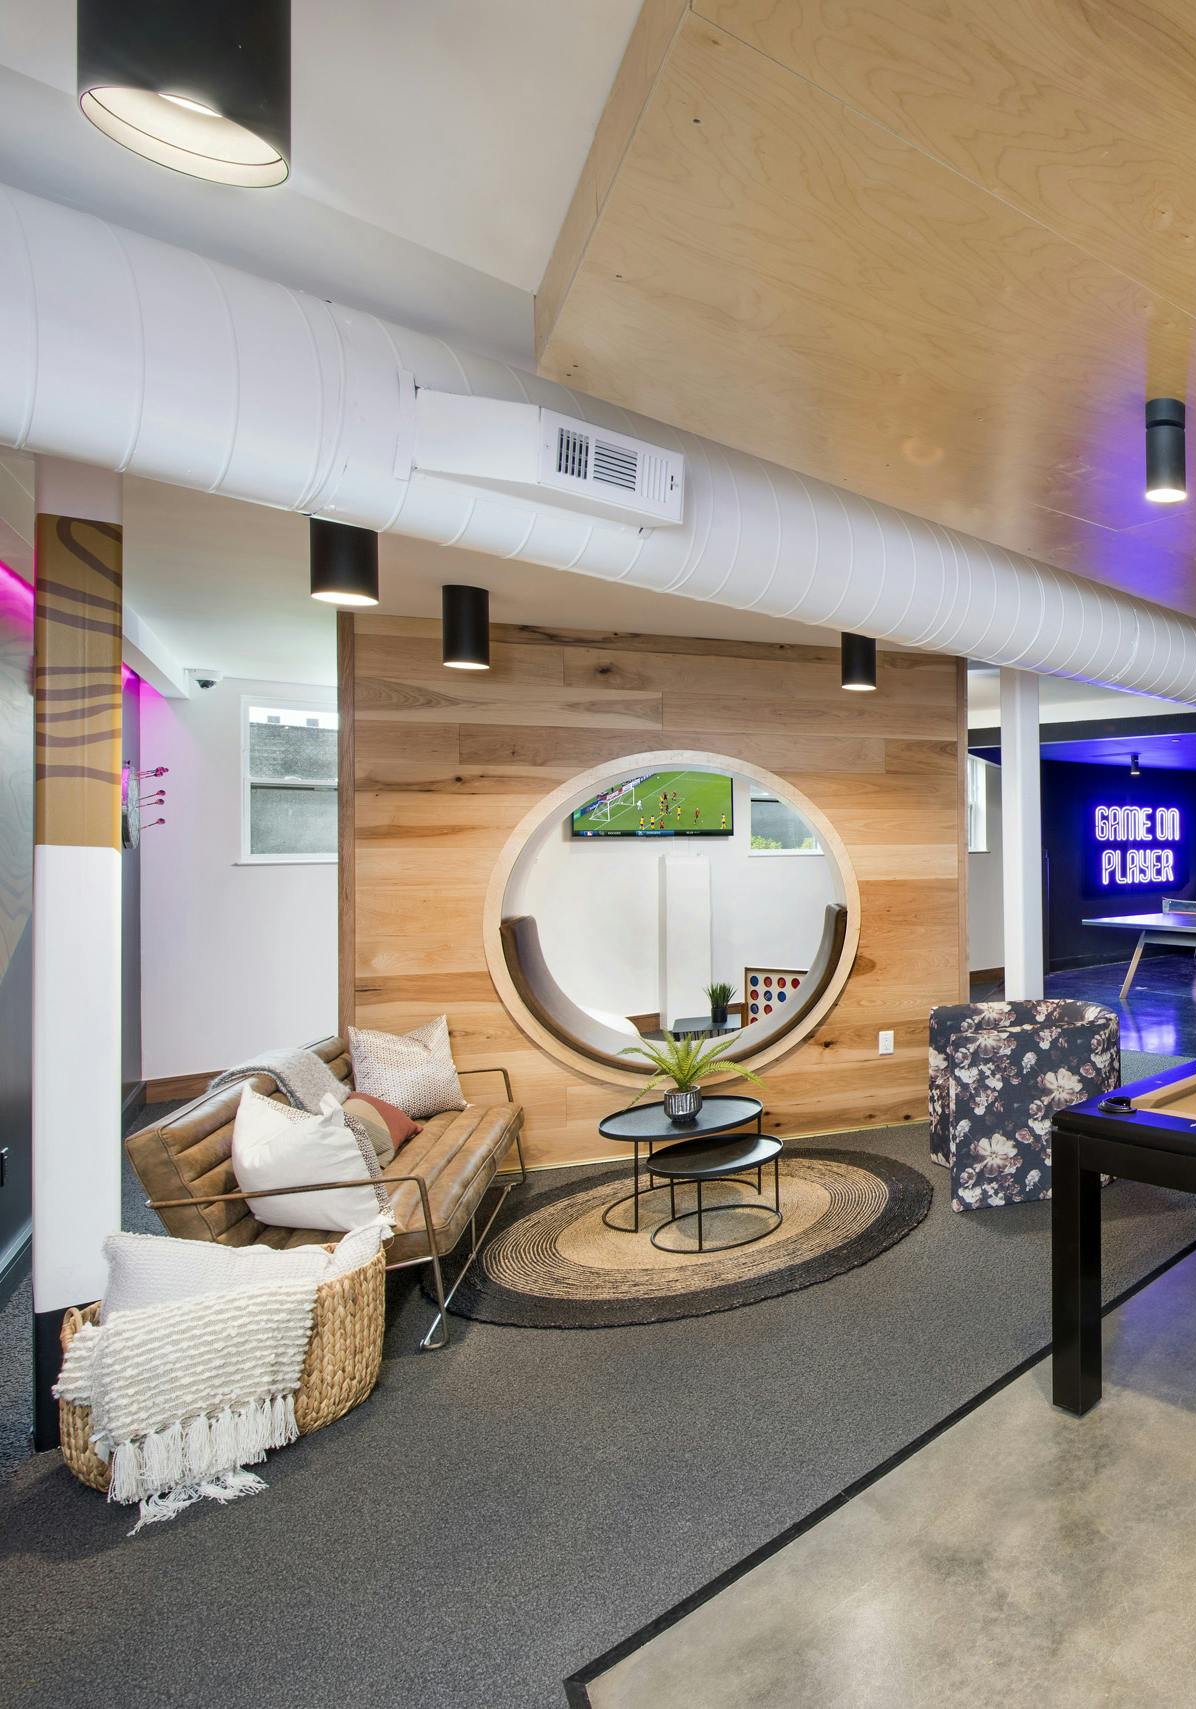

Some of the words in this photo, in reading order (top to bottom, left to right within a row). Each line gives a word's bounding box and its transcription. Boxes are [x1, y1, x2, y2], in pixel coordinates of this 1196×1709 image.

[1095, 805, 1153, 841] GAME
[1156, 807, 1180, 841] ON
[1102, 849, 1175, 885] PLAYER
